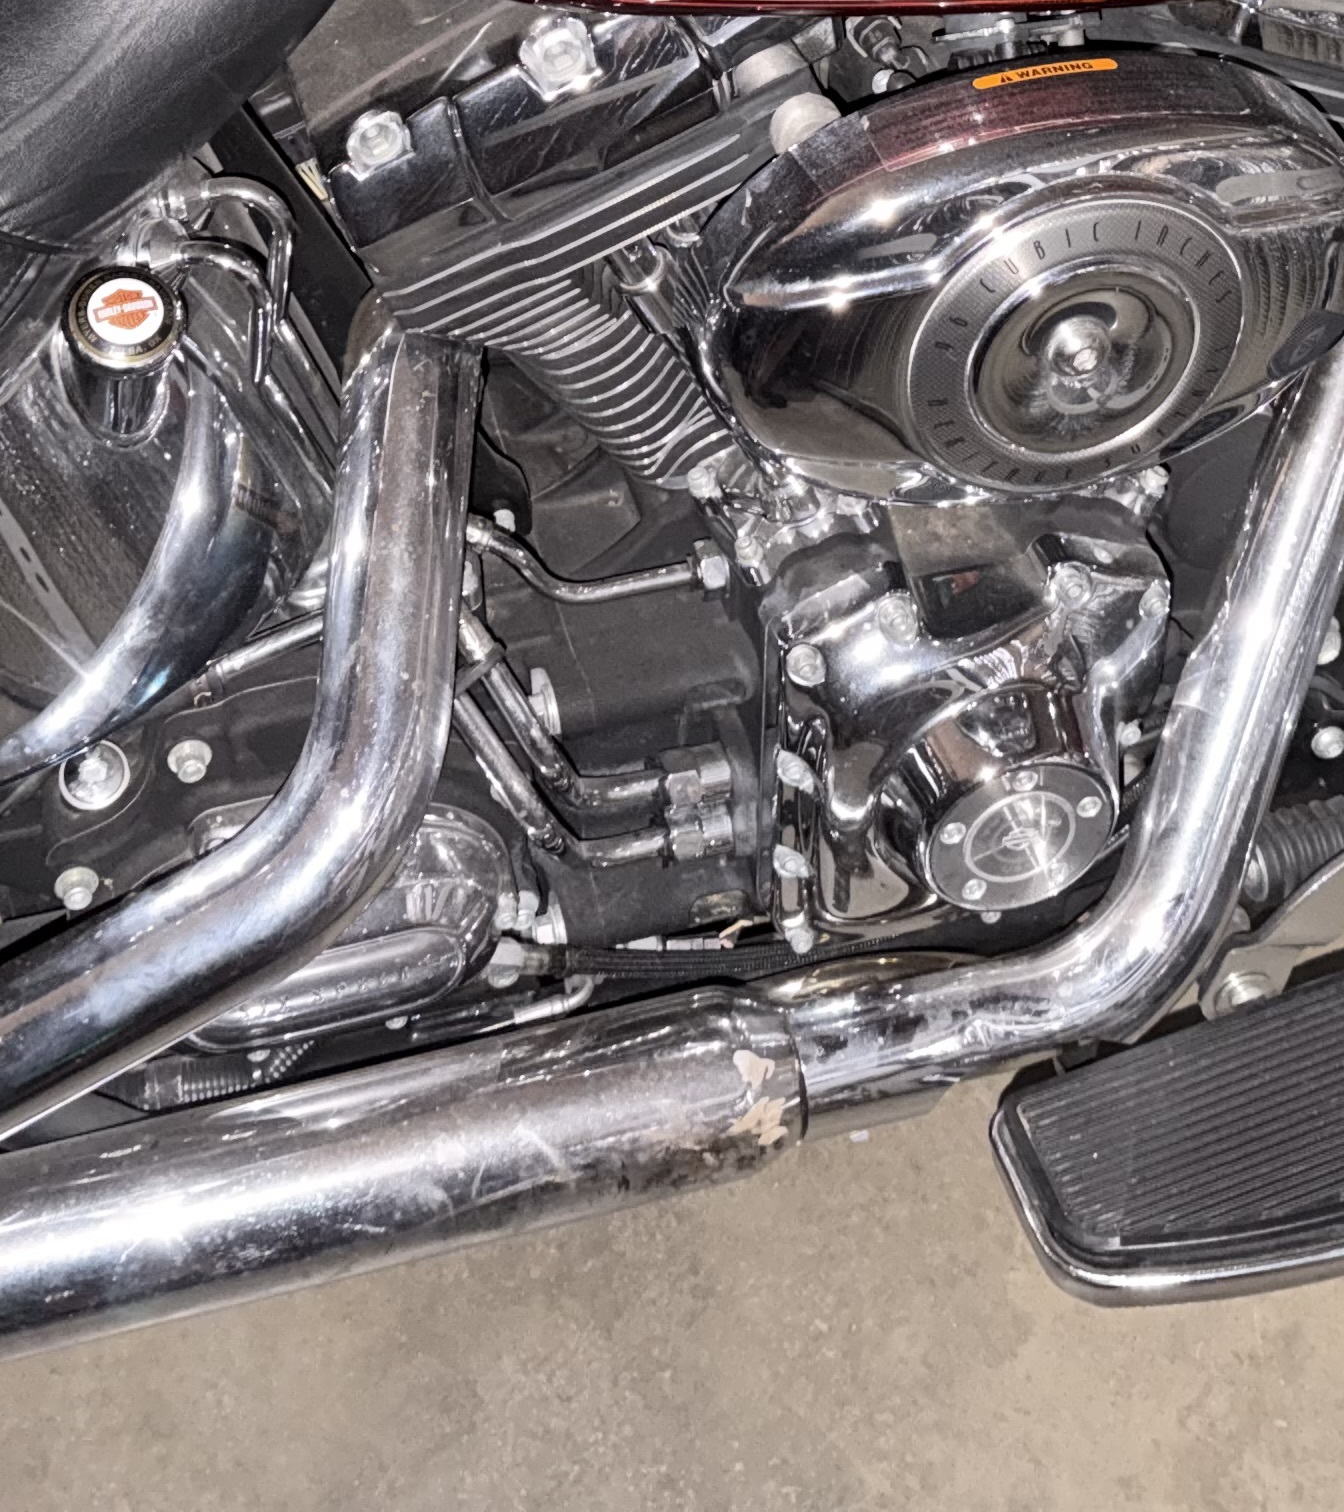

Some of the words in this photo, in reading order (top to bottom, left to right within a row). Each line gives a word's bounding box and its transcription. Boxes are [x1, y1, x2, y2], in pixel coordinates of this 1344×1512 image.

[1014, 60, 1094, 80] WARNING
[979, 220, 1102, 295] CUBIC
[1132, 218, 1235, 305] INCHES
